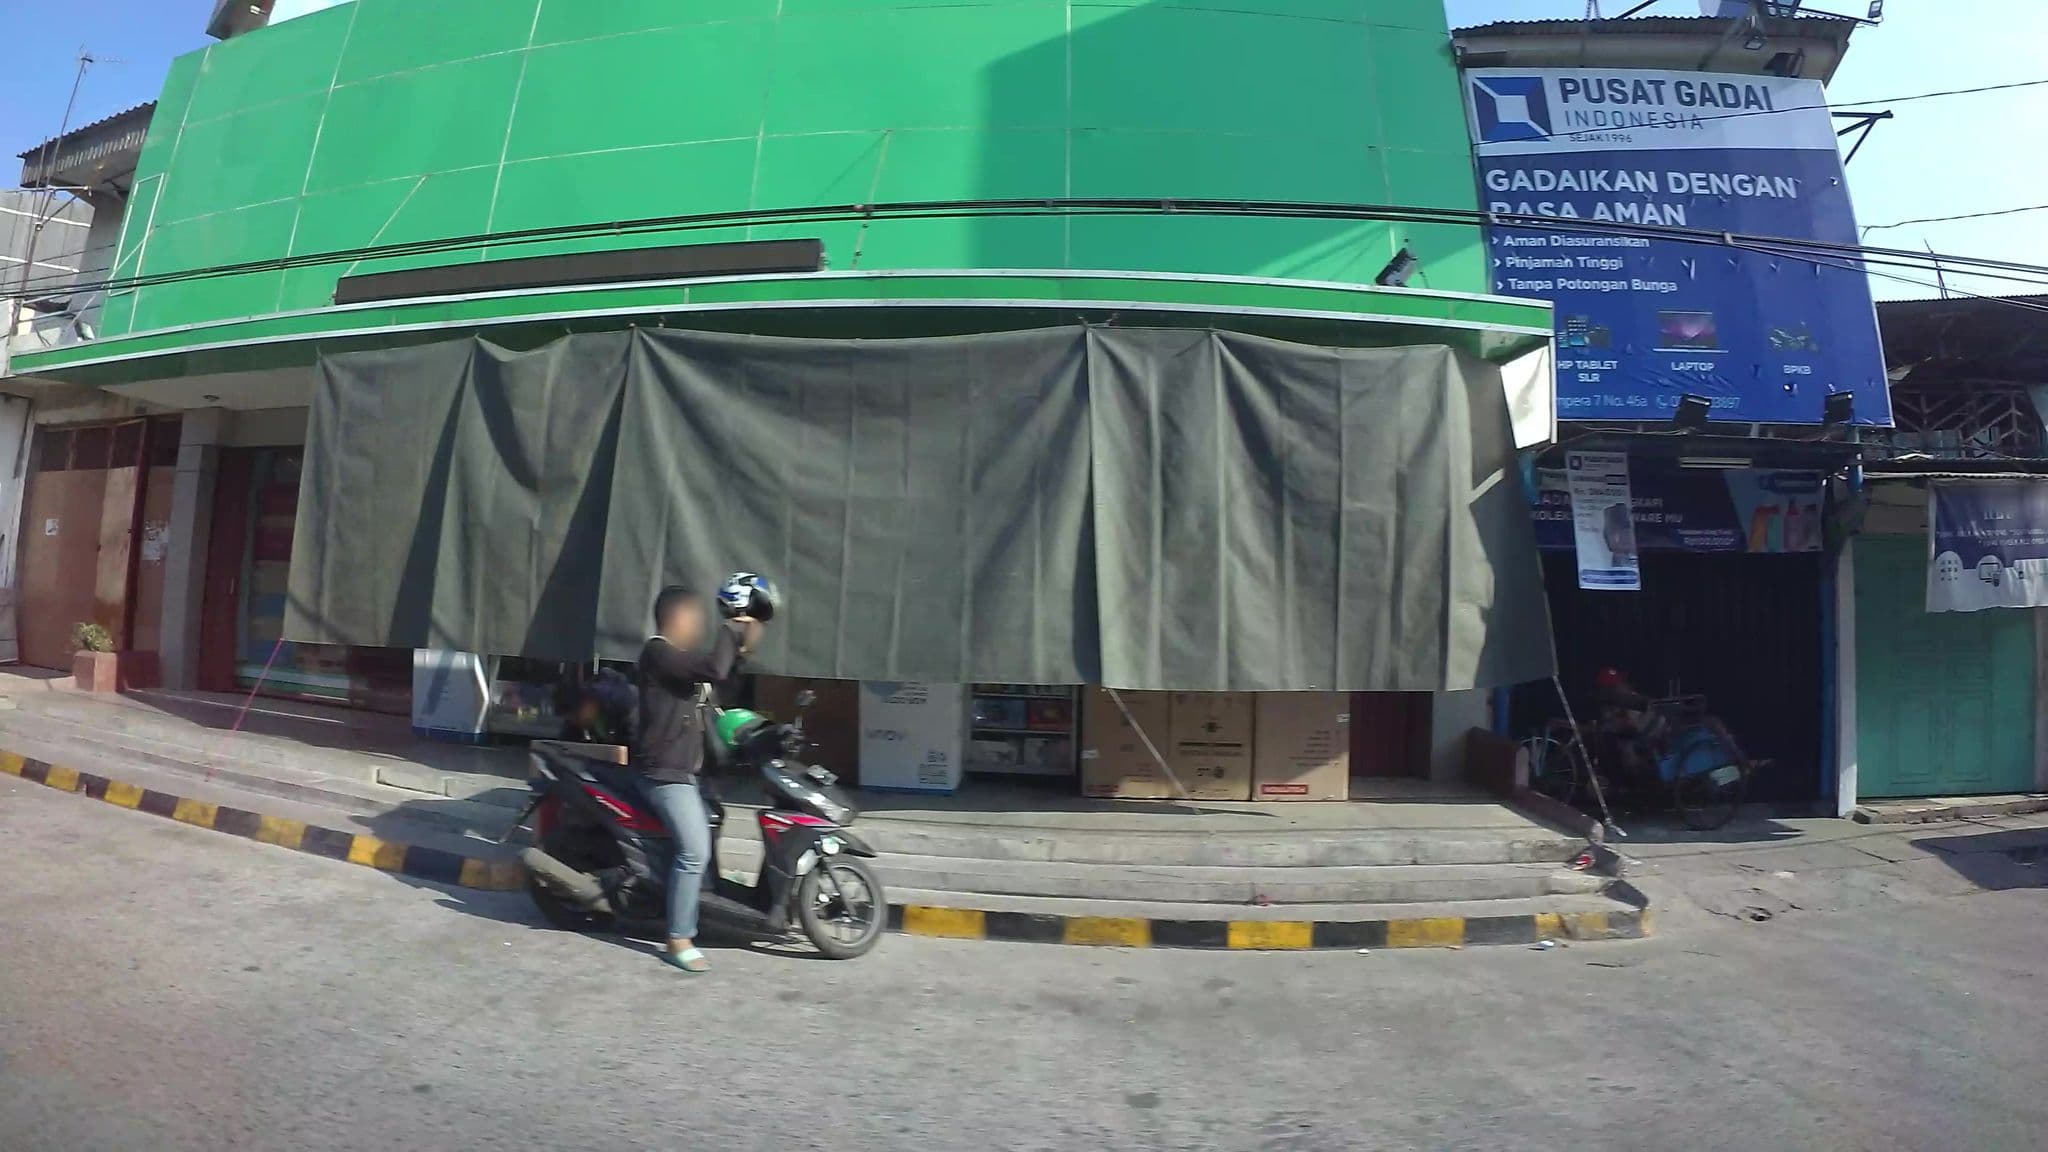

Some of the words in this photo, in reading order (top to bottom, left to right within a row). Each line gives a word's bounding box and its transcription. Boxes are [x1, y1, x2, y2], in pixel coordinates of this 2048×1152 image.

[1559, 78, 1665, 106] PUSAT
[1674, 80, 1774, 111] GADAI
[1566, 110, 1703, 130] INDONESIA
[1486, 169, 1659, 193] GADAIKAN
[1667, 171, 1798, 199] DENGAN
[1592, 203, 1686, 226] AMAN
[1503, 235, 1547, 248] Aman
[1551, 235, 1650, 249] Diasuransikan
[1505, 255, 1573, 271] Pinjaman
[1577, 255, 1623, 271] Tinggi
[1508, 278, 1554, 293] Tanpa
[1557, 278, 1628, 293] Potongan
[1631, 279, 1678, 293] Bunga
[1575, 360, 1619, 370] TABLET
[1671, 361, 1715, 372] LAPTOP
[1578, 372, 1600, 383] SLR
[1557, 396, 1592, 410] mpera
